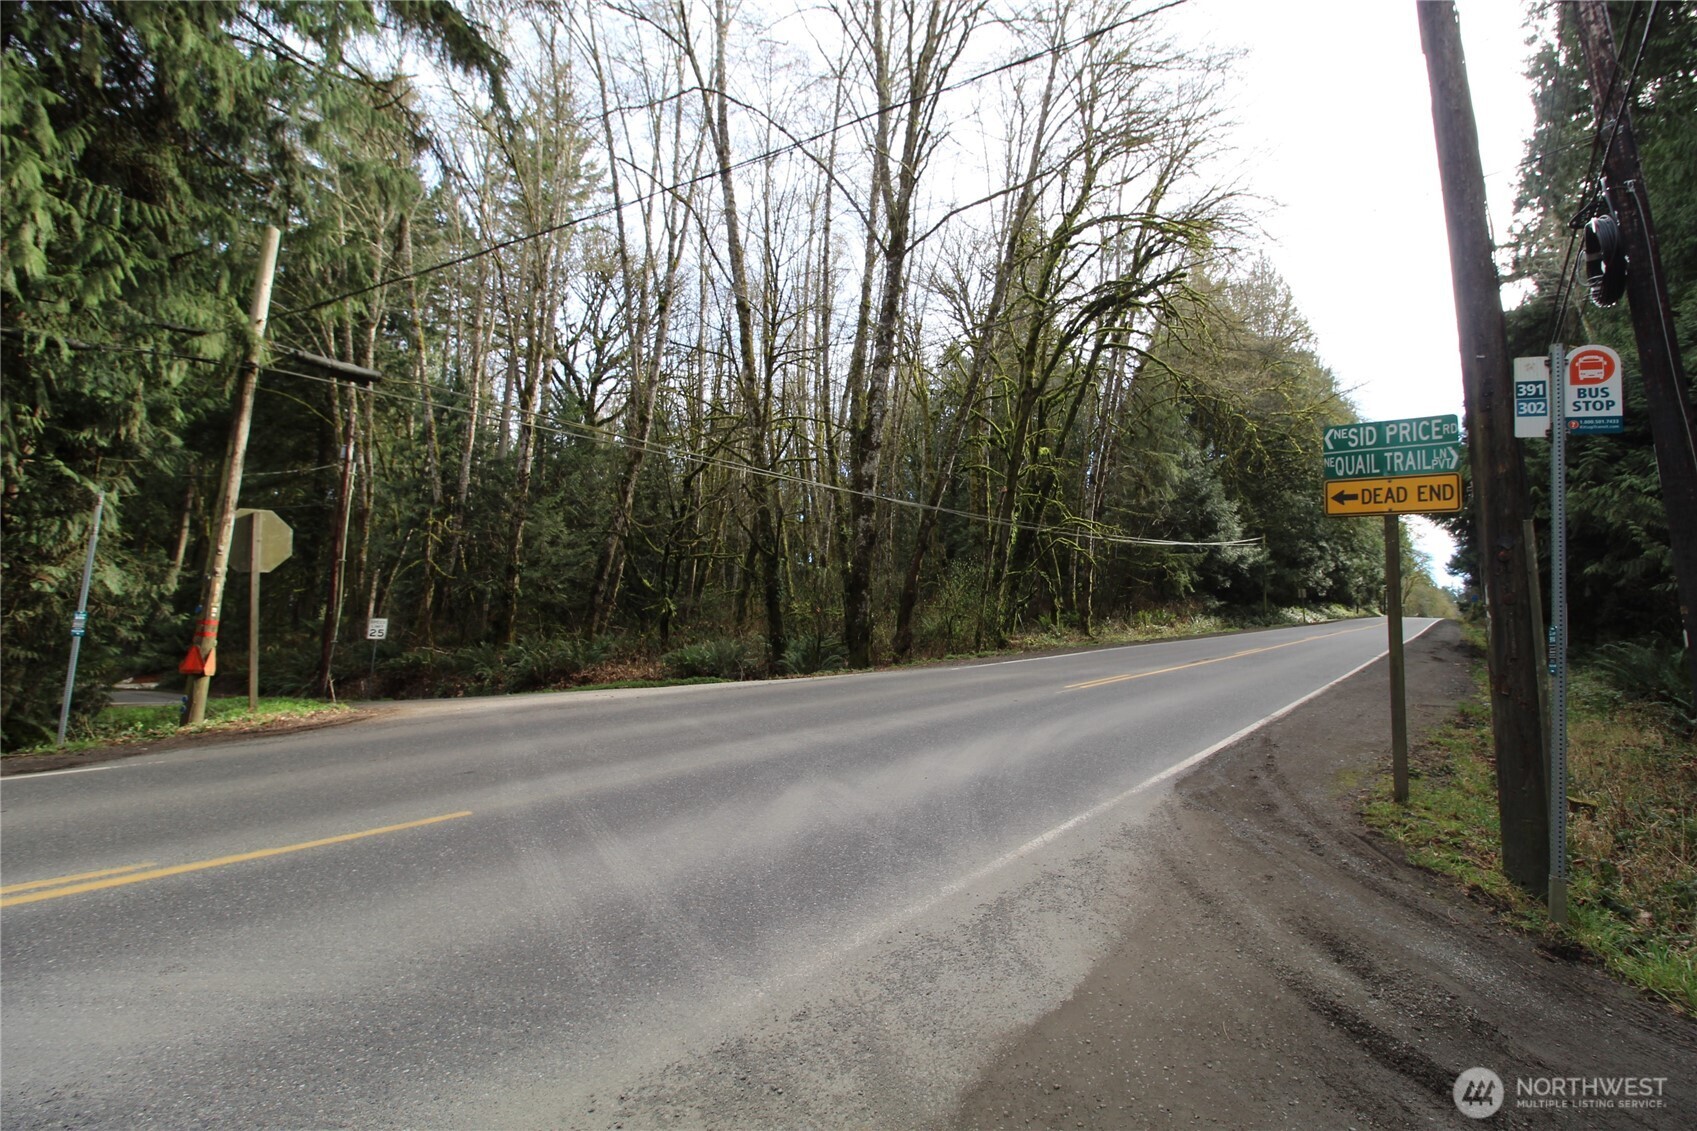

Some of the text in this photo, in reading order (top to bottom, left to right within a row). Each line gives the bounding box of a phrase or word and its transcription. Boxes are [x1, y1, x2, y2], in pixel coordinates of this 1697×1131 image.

[1517, 383, 1545, 397] 391
[1577, 387, 1610, 399] BUS
[1518, 402, 1546, 415] 302
[1572, 400, 1616, 412] STOP
[1333, 419, 1458, 448] NE SID PRICE RD
[1324, 448, 1451, 476] NE QUAIL TRAIL LN PVT
[1361, 483, 1455, 505] DEAD END
[369, 628, 385, 637] 25
